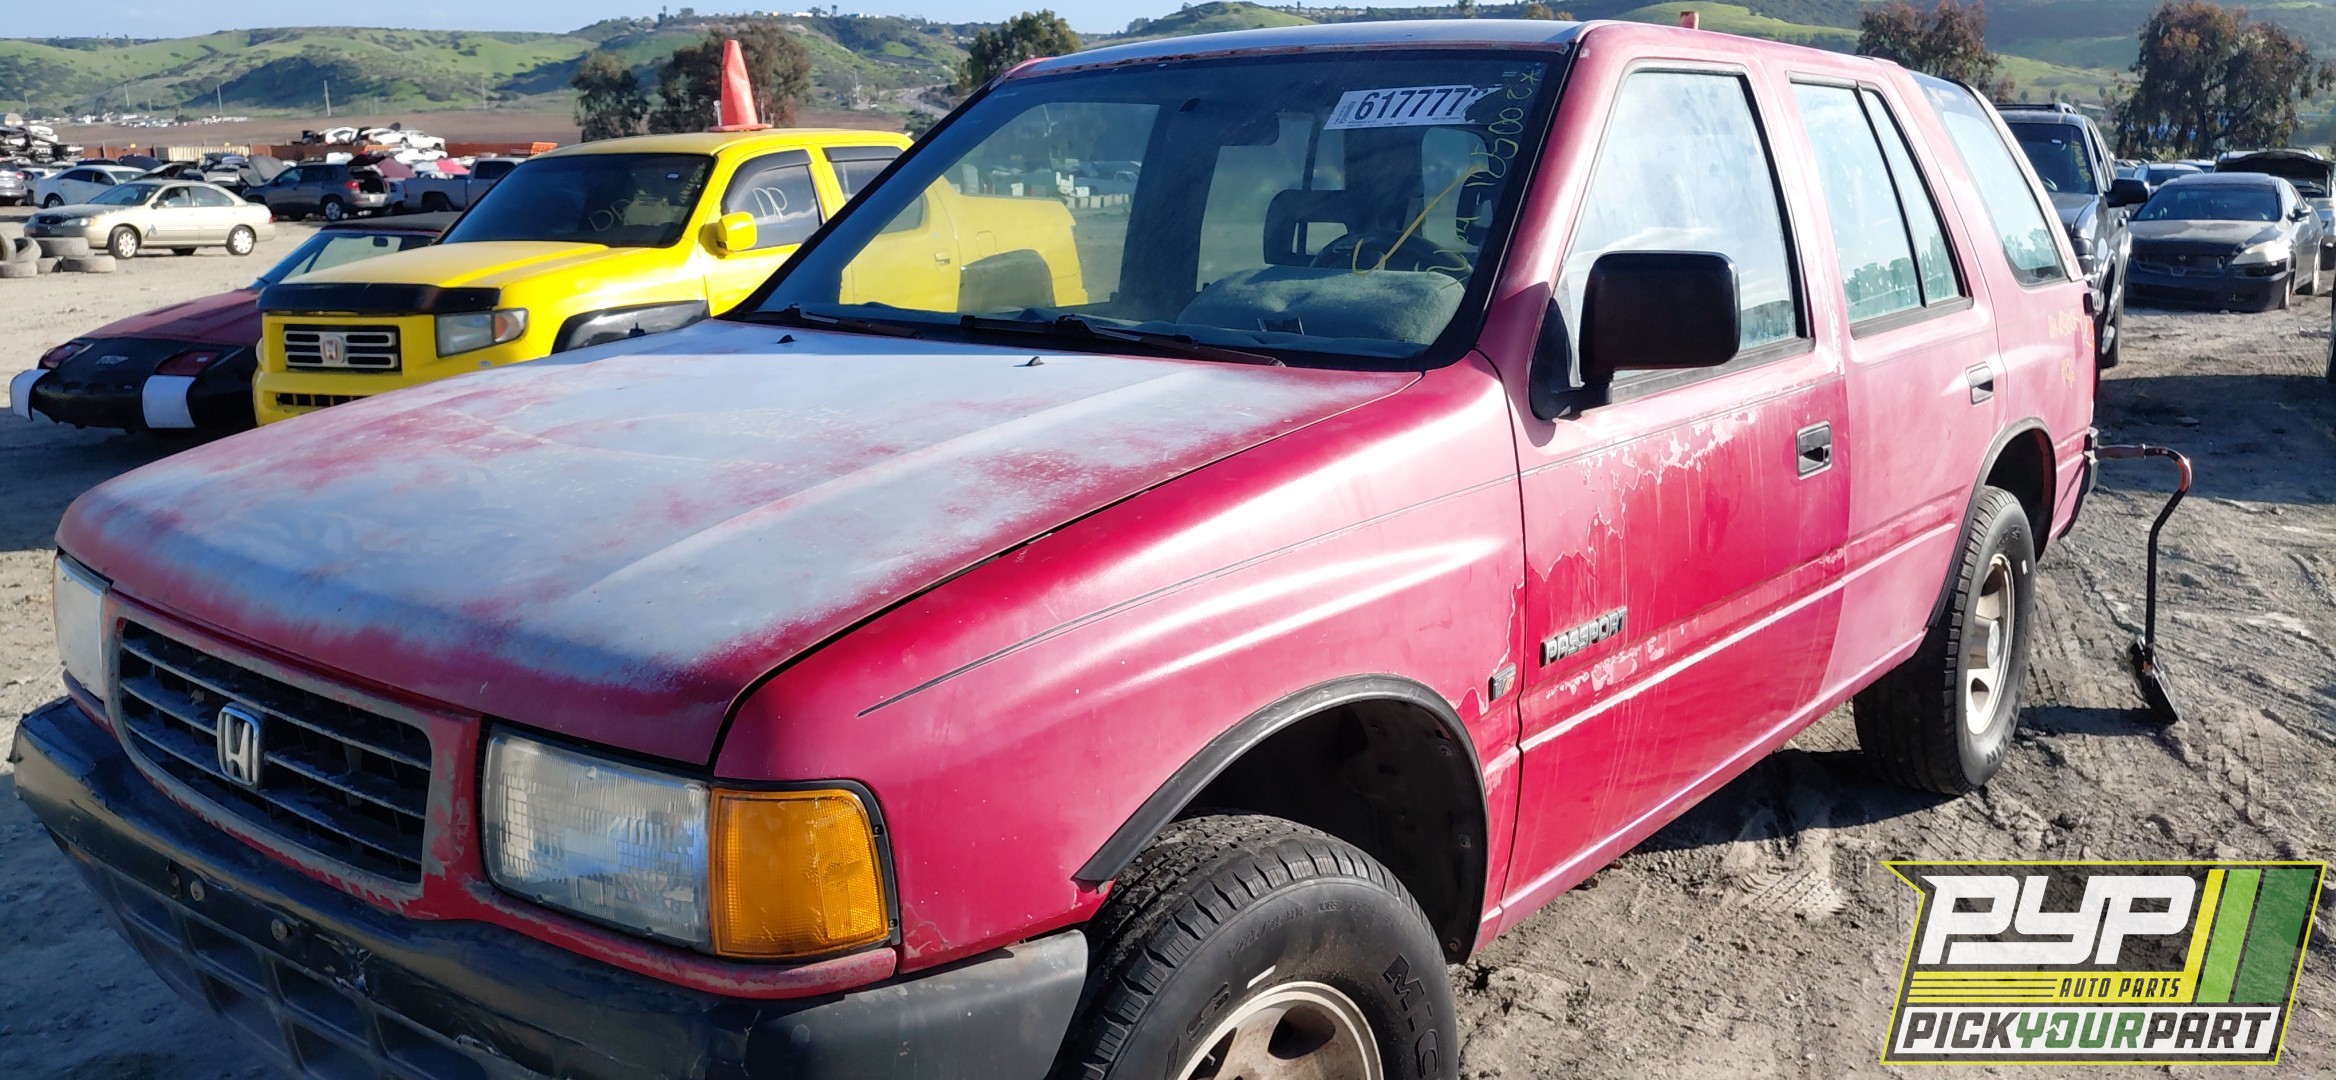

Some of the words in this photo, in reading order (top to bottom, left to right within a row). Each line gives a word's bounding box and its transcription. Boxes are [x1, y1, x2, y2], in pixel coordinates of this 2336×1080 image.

[1354, 87, 1488, 121] 617777
[752, 187, 788, 220] DP
[1542, 607, 1628, 667] PASSPORT
